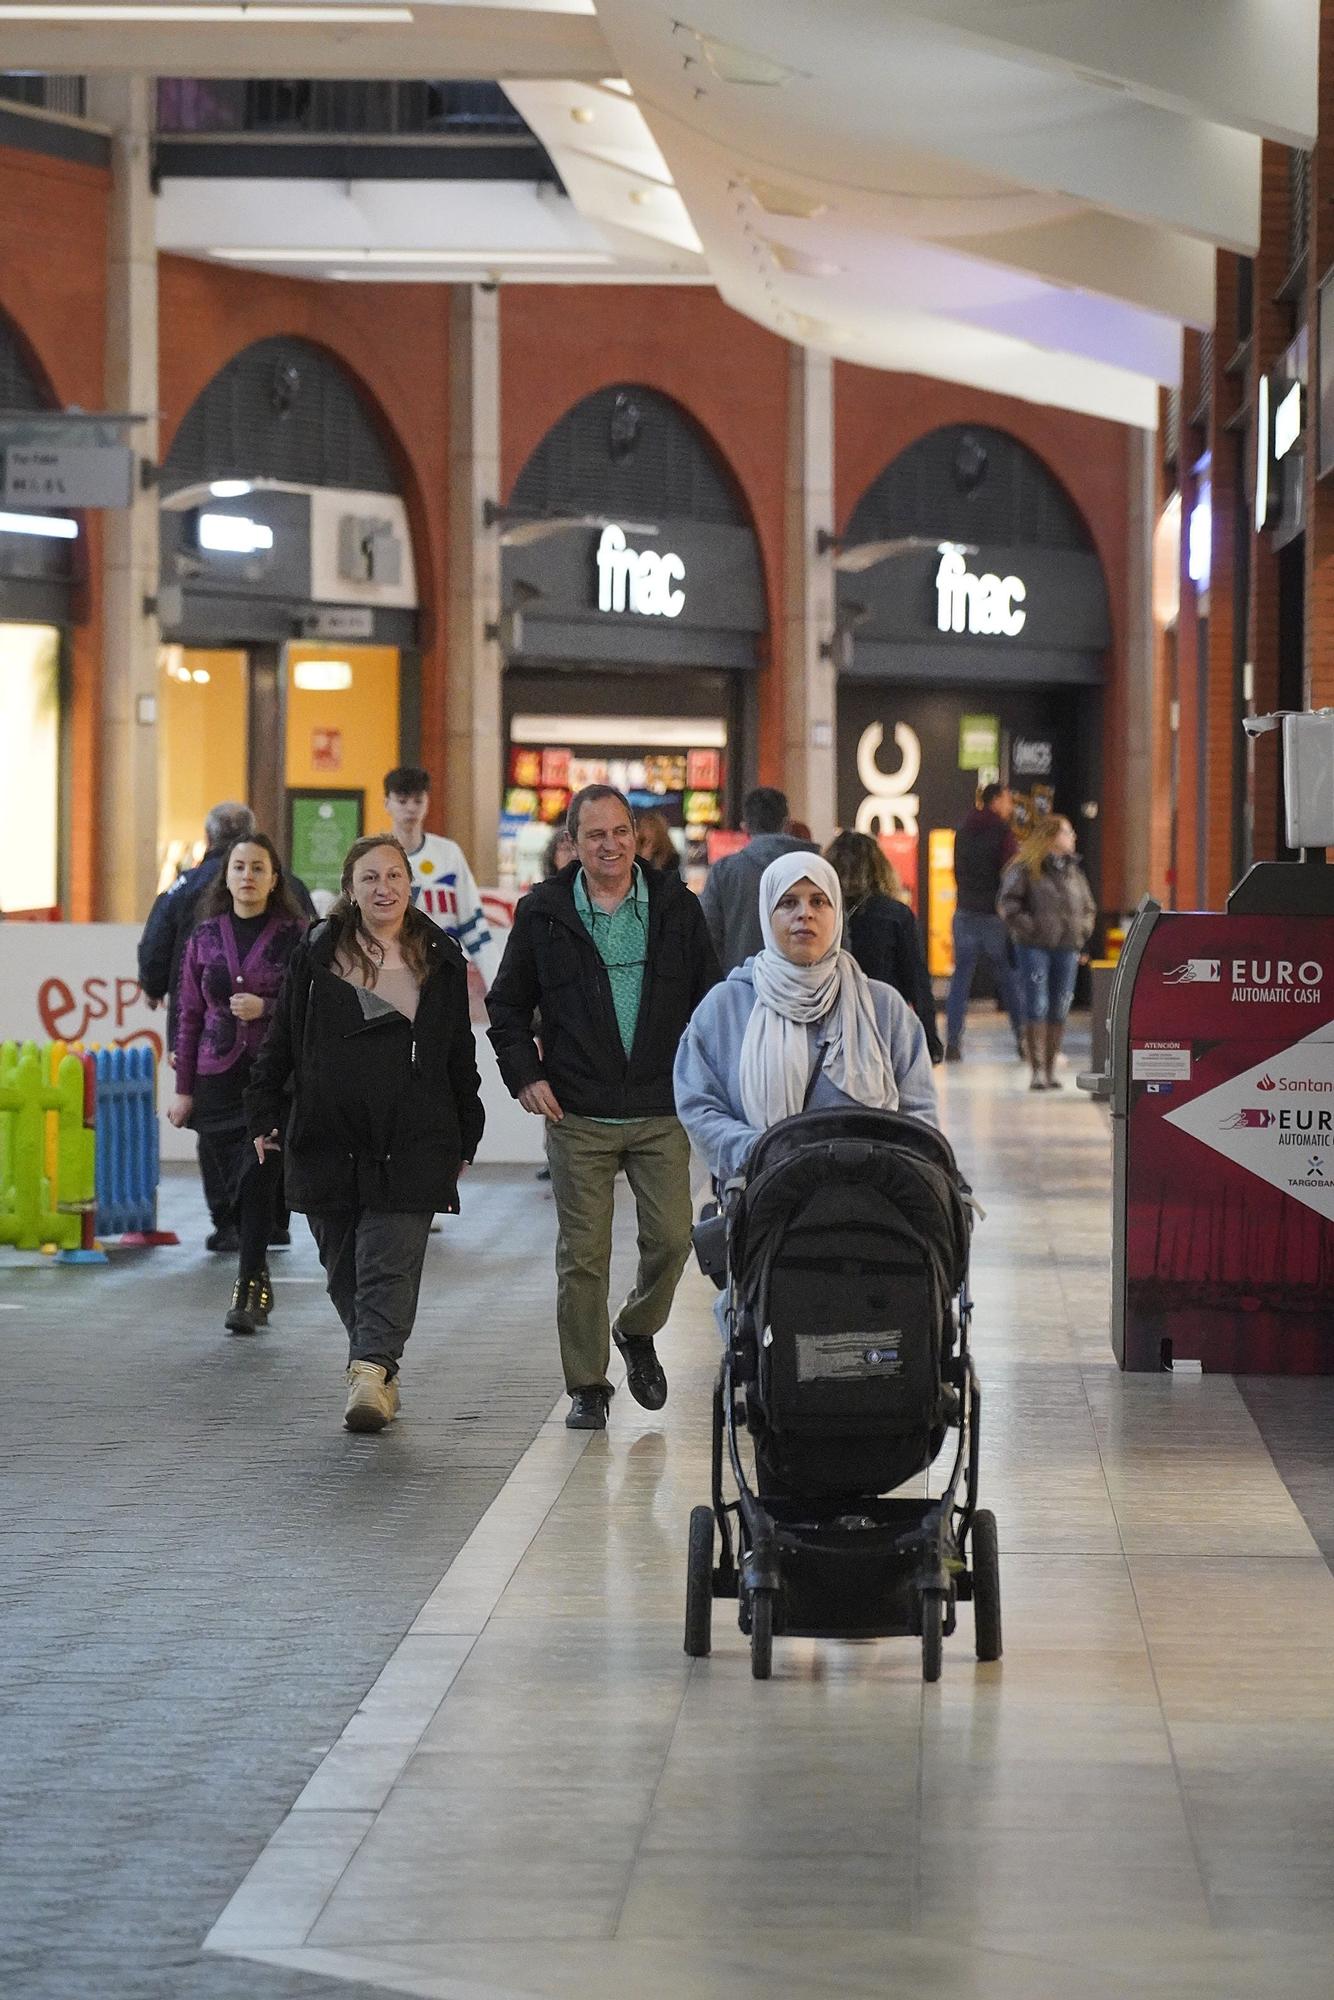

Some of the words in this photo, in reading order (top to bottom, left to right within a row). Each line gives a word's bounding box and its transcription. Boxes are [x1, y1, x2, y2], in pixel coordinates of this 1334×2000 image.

[597, 524, 685, 617] fnac
[936, 548, 1026, 636] fnac
[1232, 960, 1323, 985] EURO
[1232, 988, 1291, 1002] AUTOMATIC
[1294, 989, 1321, 1003] CASH
[1279, 1133, 1331, 1146] AUTOMATIC
